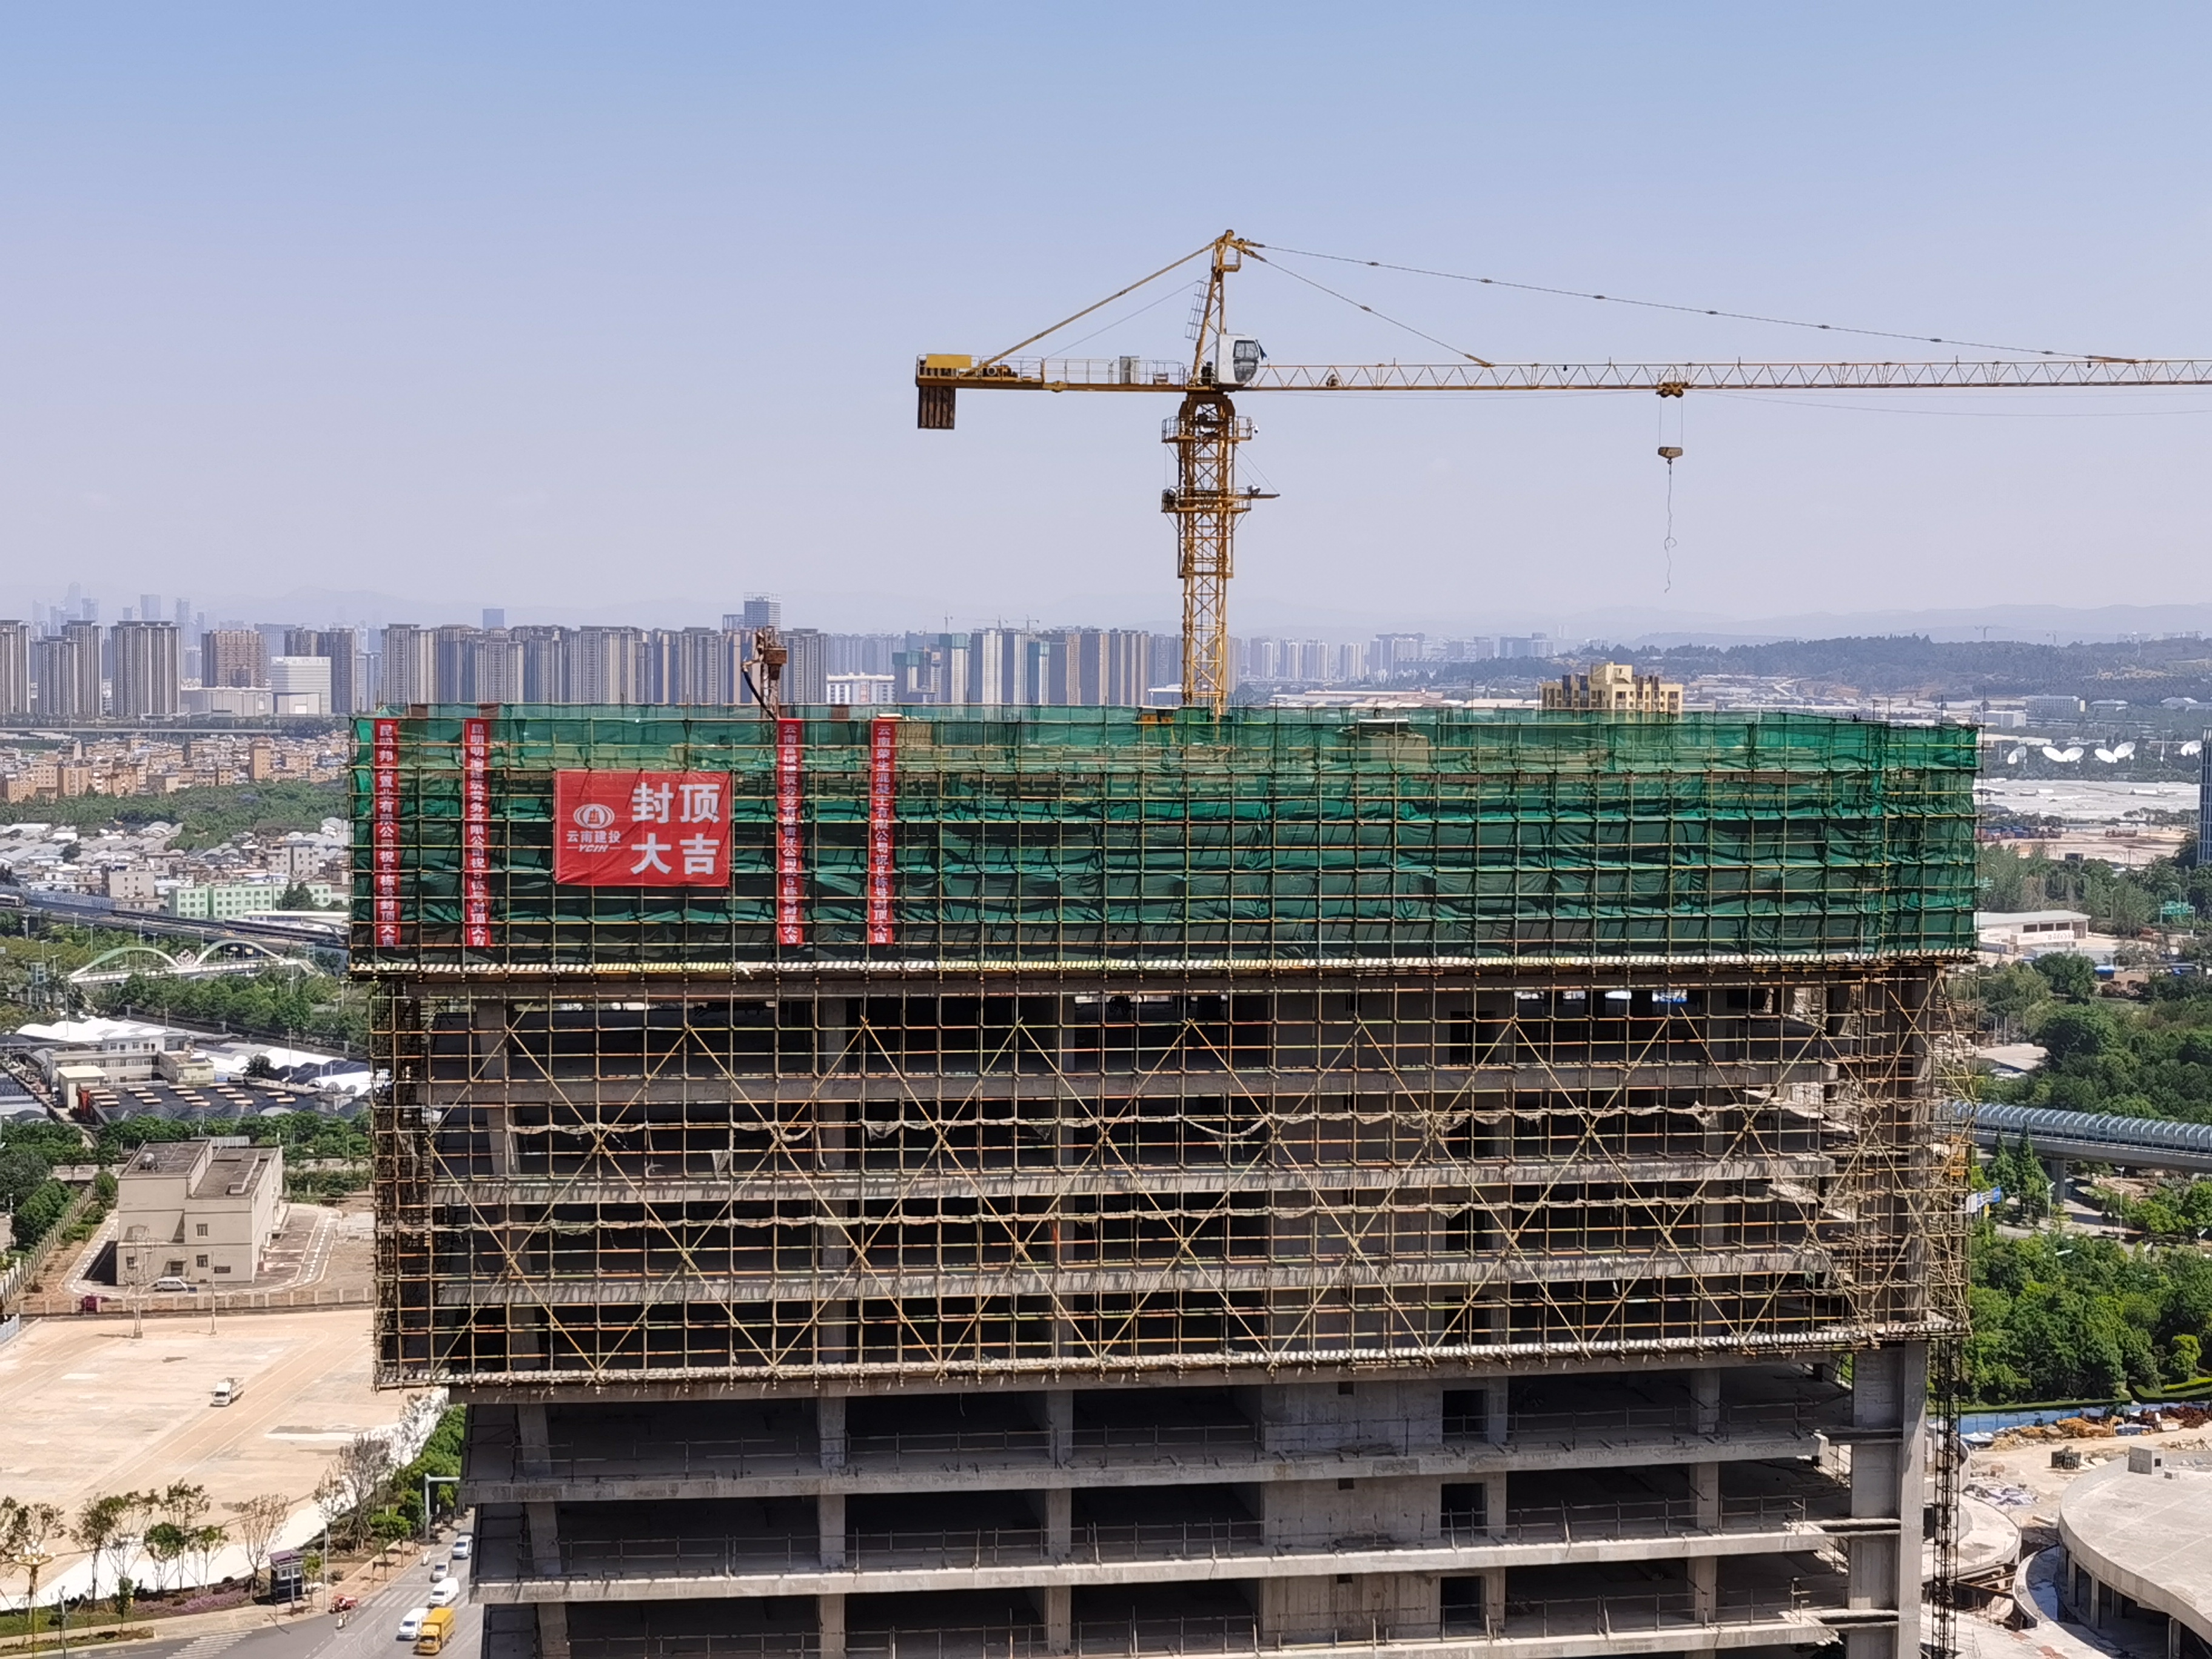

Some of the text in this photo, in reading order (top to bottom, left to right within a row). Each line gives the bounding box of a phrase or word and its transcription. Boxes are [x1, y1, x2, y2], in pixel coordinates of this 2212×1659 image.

[632, 782, 720, 823] 封顶
[566, 830, 621, 843] 云南建投
[631, 833, 720, 875] 大吉
